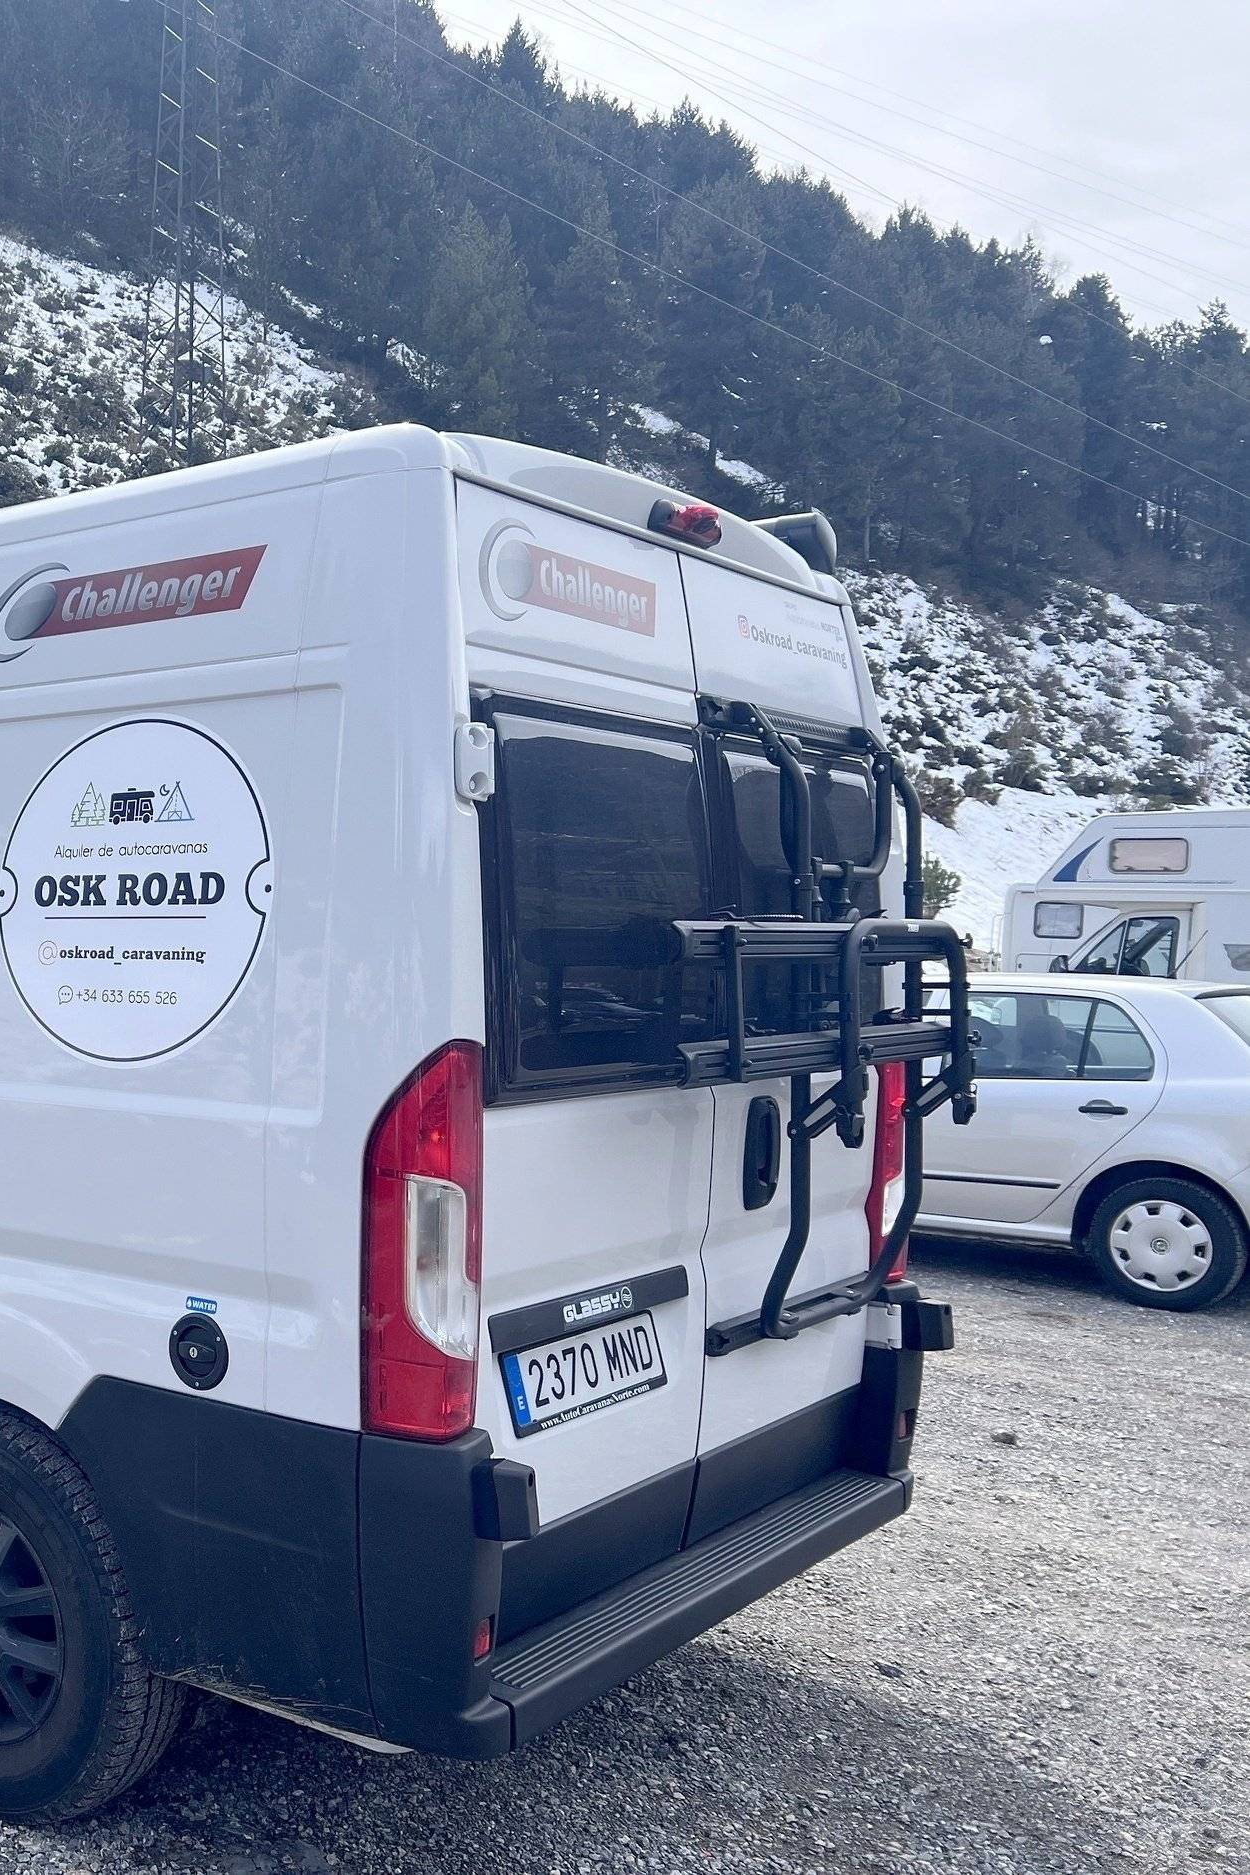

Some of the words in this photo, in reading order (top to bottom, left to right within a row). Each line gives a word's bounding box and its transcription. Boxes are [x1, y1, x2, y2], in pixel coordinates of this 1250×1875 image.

[61, 566, 241, 622] Challenger
[540, 557, 648, 627] Challenger
[751, 625, 847, 669] Oskroad_caravaning
[54, 844, 93, 859] Alquiler
[98, 843, 113, 857] de
[118, 841, 208, 857] autocaravanas
[34, 875, 107, 907] OSK
[116, 872, 225, 906] ROAD
[76, 989, 97, 1002] +34
[101, 989, 123, 1003] 633
[128, 990, 150, 1004] 655
[155, 991, 177, 1005] 526
[192, 1300, 216, 1312] WATER
[528, 1343, 599, 1408] 2370
[602, 1325, 653, 1381] MND
[517, 1395, 526, 1411] E
[540, 1383, 650, 1429] www.AutoCaravanasNorte.com
